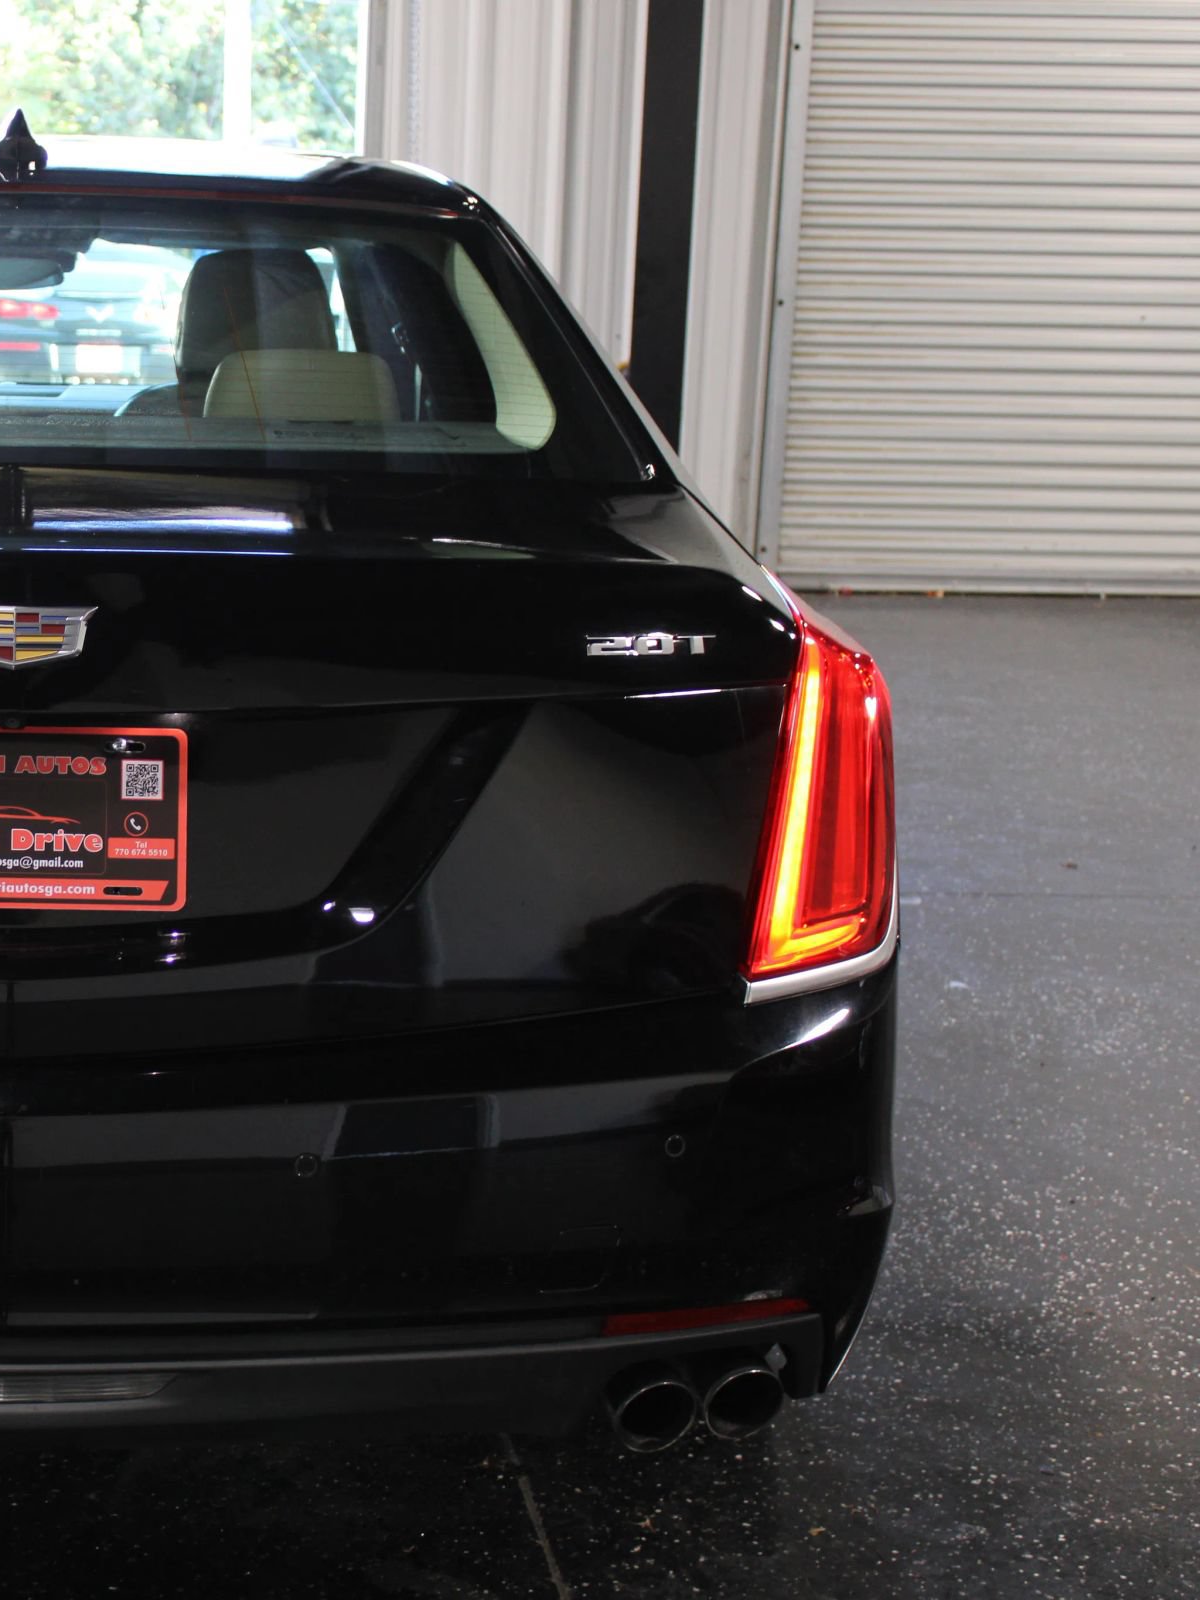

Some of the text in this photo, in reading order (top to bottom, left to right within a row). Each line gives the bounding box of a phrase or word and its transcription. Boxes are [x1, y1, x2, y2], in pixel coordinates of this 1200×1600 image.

[14, 755, 107, 775] AUTOS
[11, 828, 104, 853] Drive
[135, 841, 148, 849] Tel
[114, 848, 129, 856] 770
[148, 849, 168, 857] 5510
